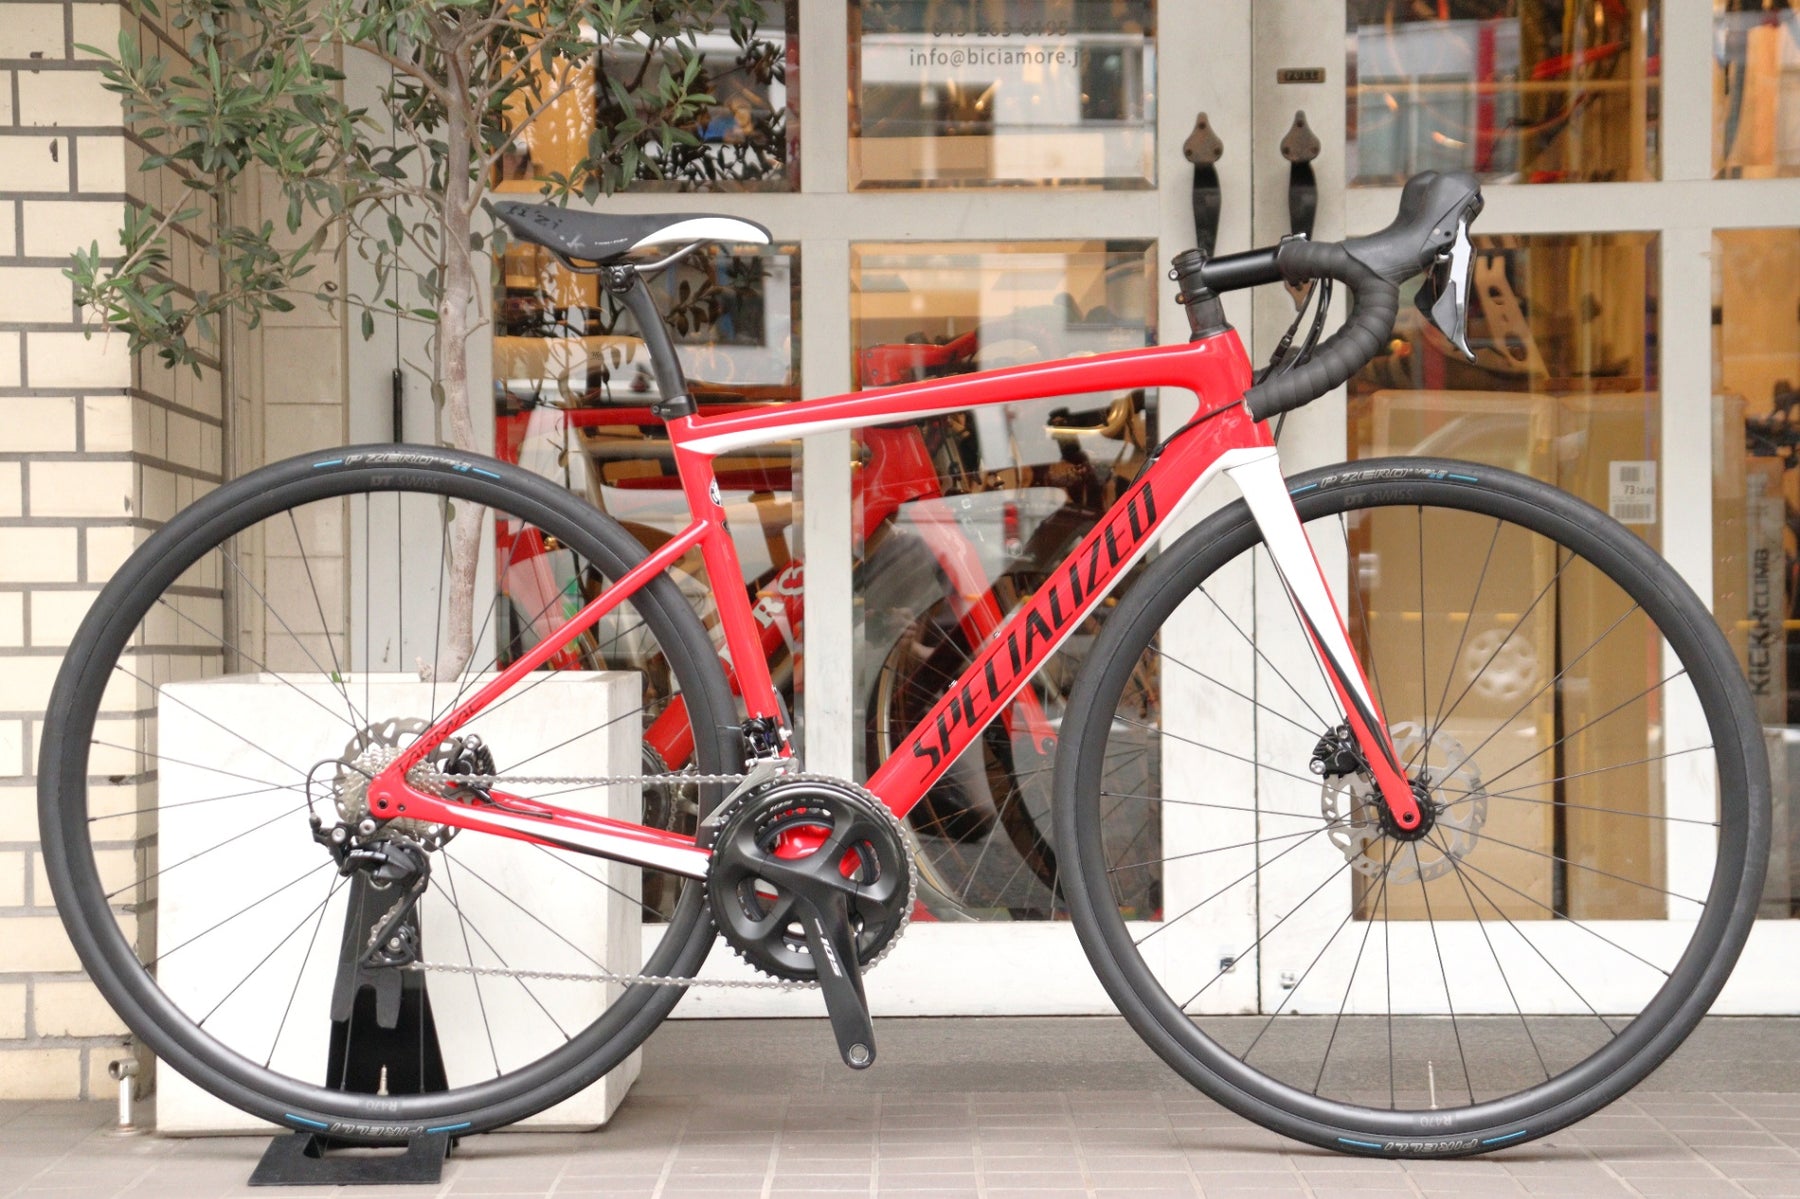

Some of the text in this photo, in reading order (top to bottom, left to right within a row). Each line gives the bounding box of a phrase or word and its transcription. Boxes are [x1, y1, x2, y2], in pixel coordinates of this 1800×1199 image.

[365, 453, 434, 465] ZERO
[397, 475, 442, 487] SWISS
[1340, 468, 1409, 483] ZERO
[1370, 488, 1414, 501] SWISS
[913, 481, 1158, 784] SPECIALIZED
[1384, 1138, 1479, 1152] PIRELLI
